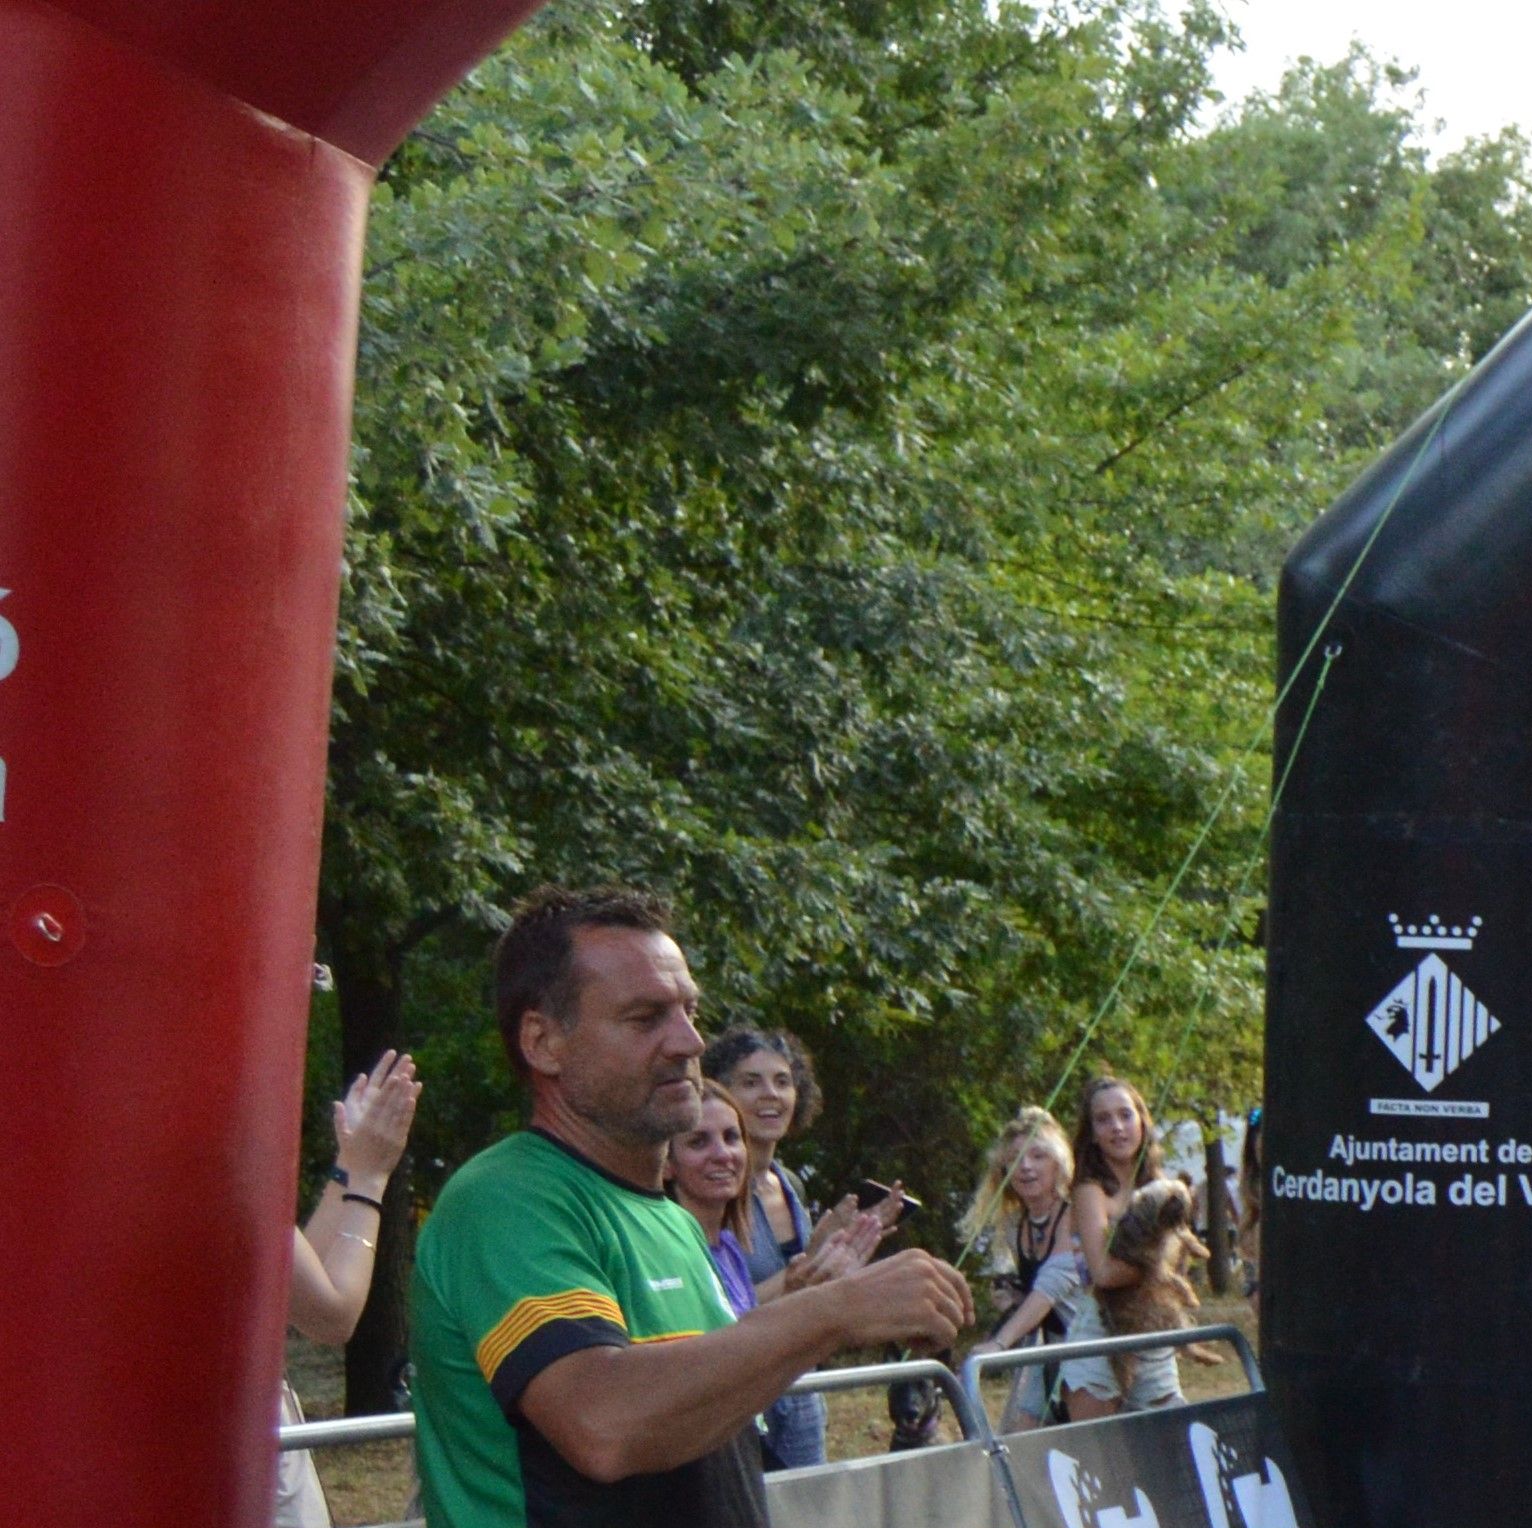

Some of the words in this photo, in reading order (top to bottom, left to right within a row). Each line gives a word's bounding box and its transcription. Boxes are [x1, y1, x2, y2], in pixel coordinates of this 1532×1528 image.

[1328, 1134, 1490, 1166] Ajuntament
[1497, 1138, 1532, 1163] de
[1272, 1165, 1437, 1211] Cerdanyola
[1449, 1173, 1507, 1206] del
